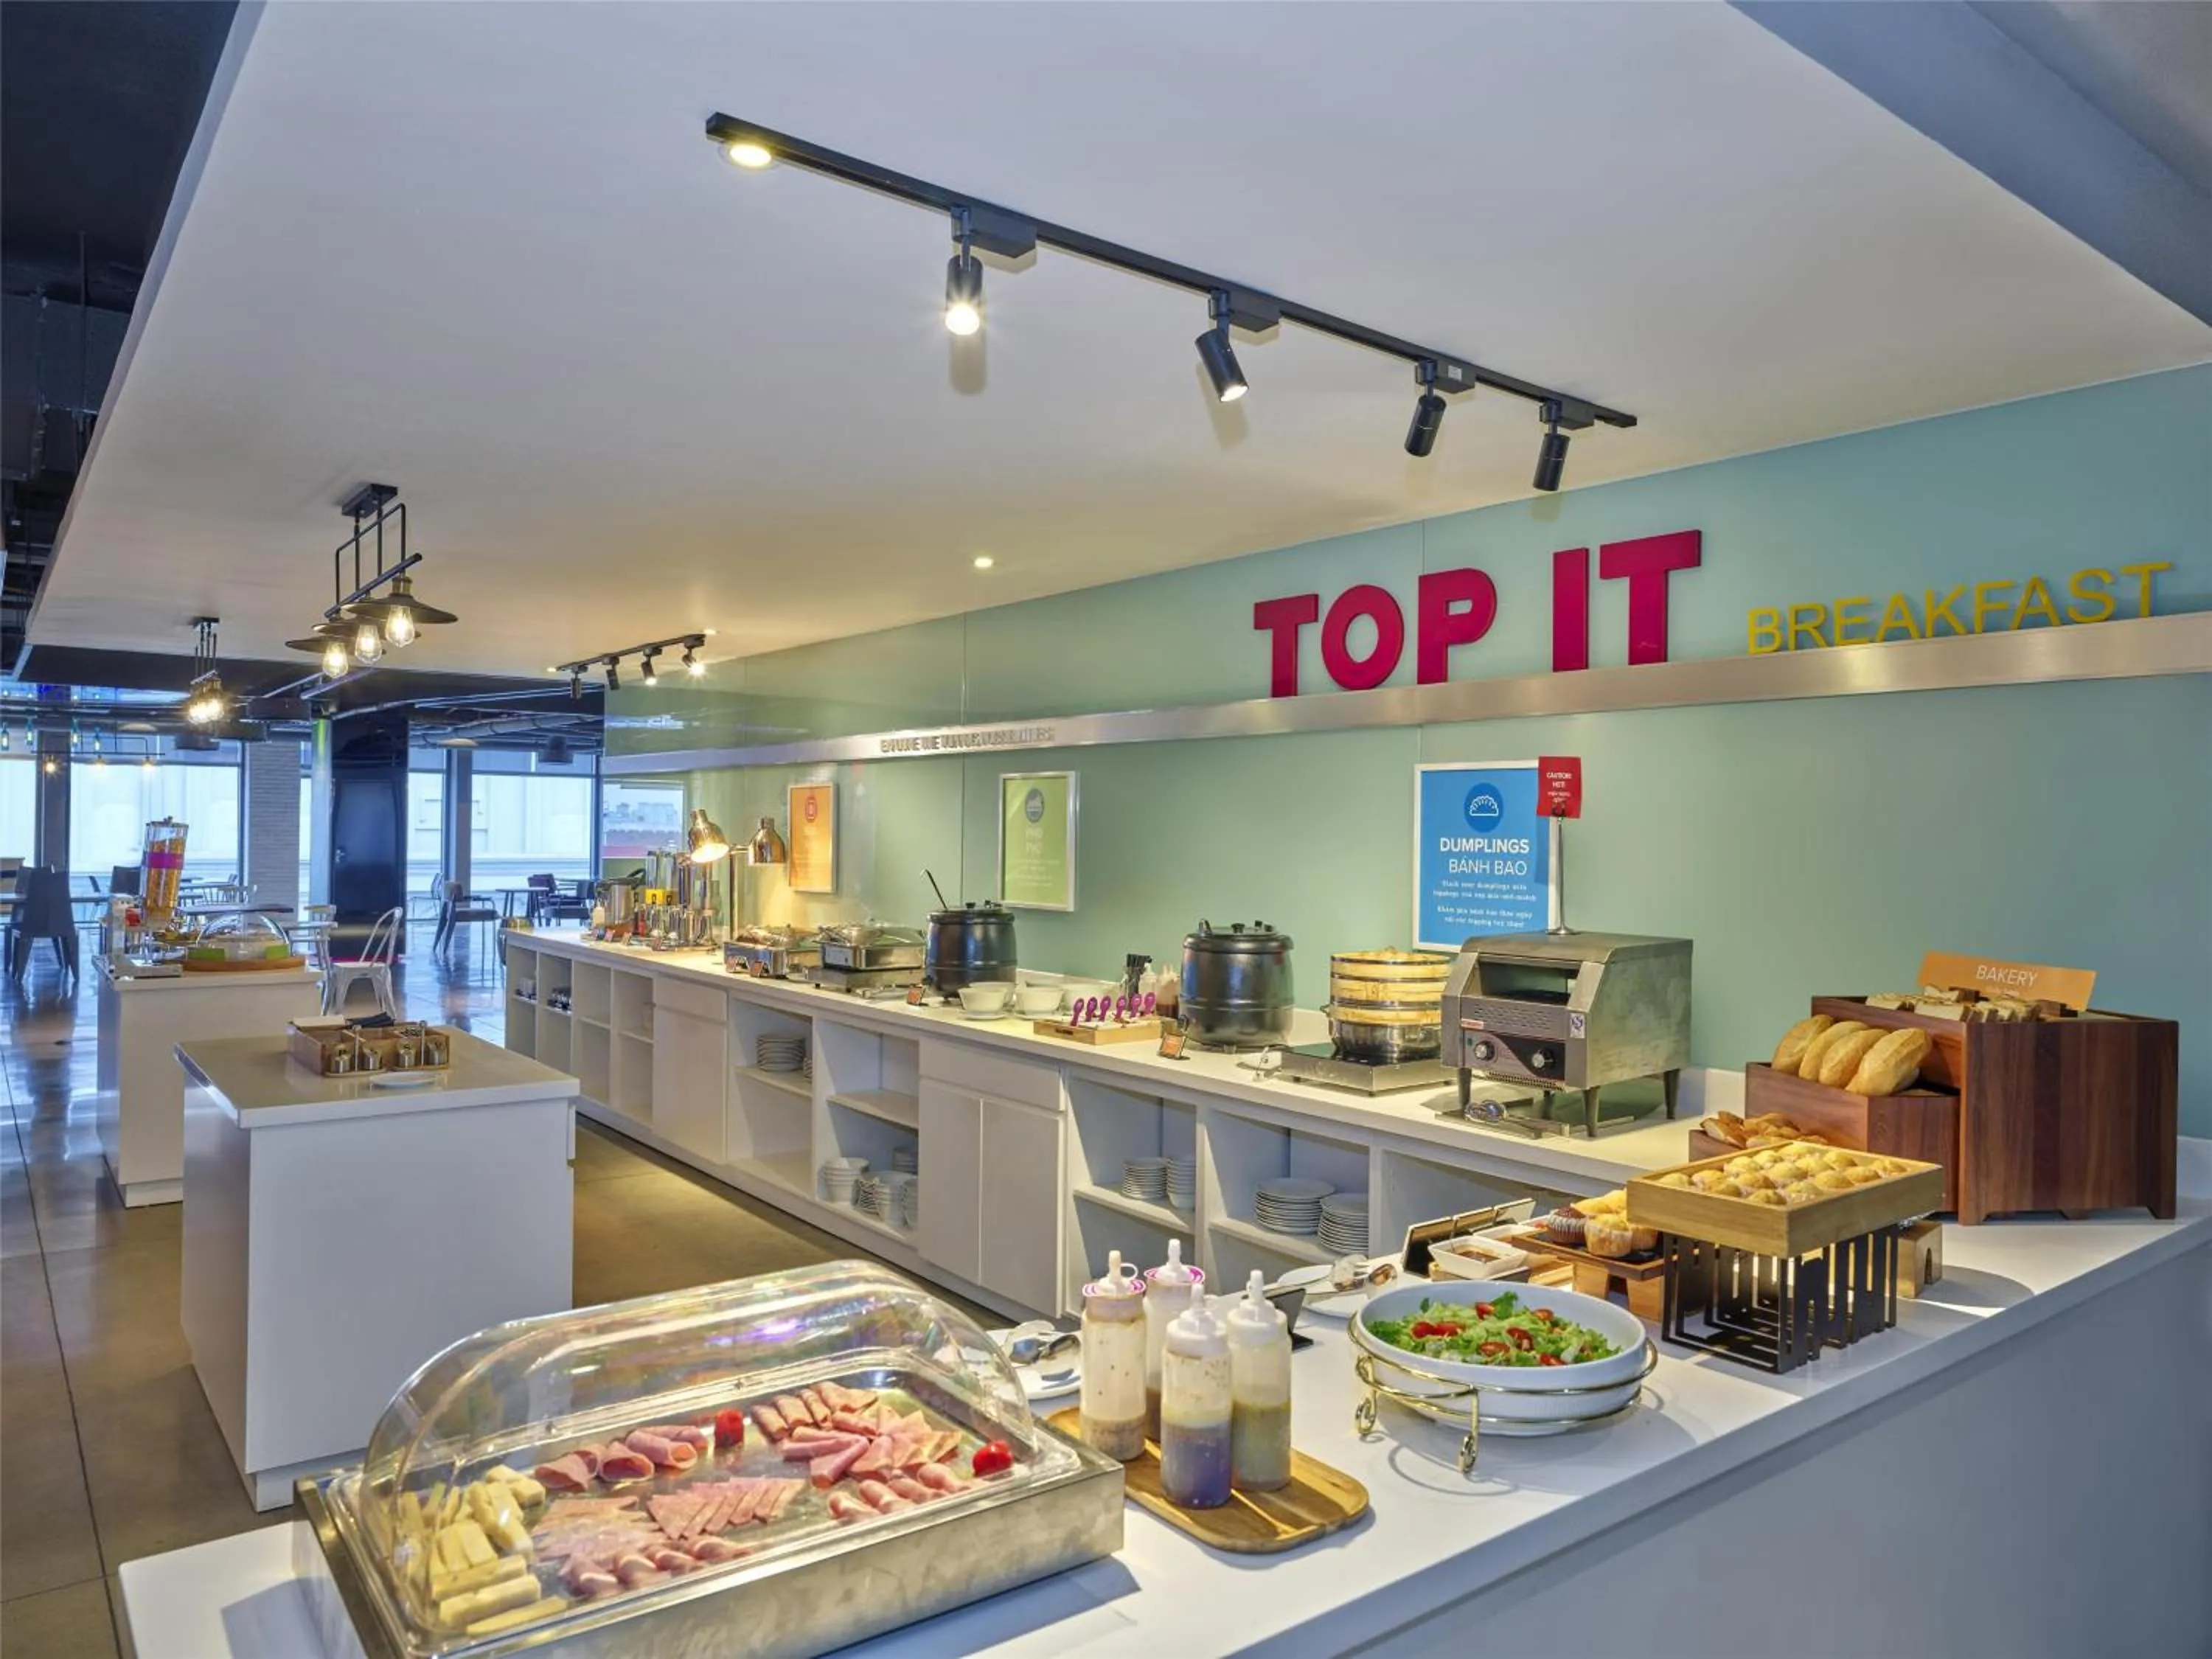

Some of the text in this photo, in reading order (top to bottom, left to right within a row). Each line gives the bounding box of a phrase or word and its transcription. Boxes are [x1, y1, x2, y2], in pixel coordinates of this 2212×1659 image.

[1253, 529, 1702, 698] TOP IT
[1746, 561, 2173, 655] BREAKFAST
[1439, 837, 1530, 854] DUMPLINGS
[1449, 855, 1528, 876] BÁNH BAO
[1977, 964, 2038, 987] BAKERY
